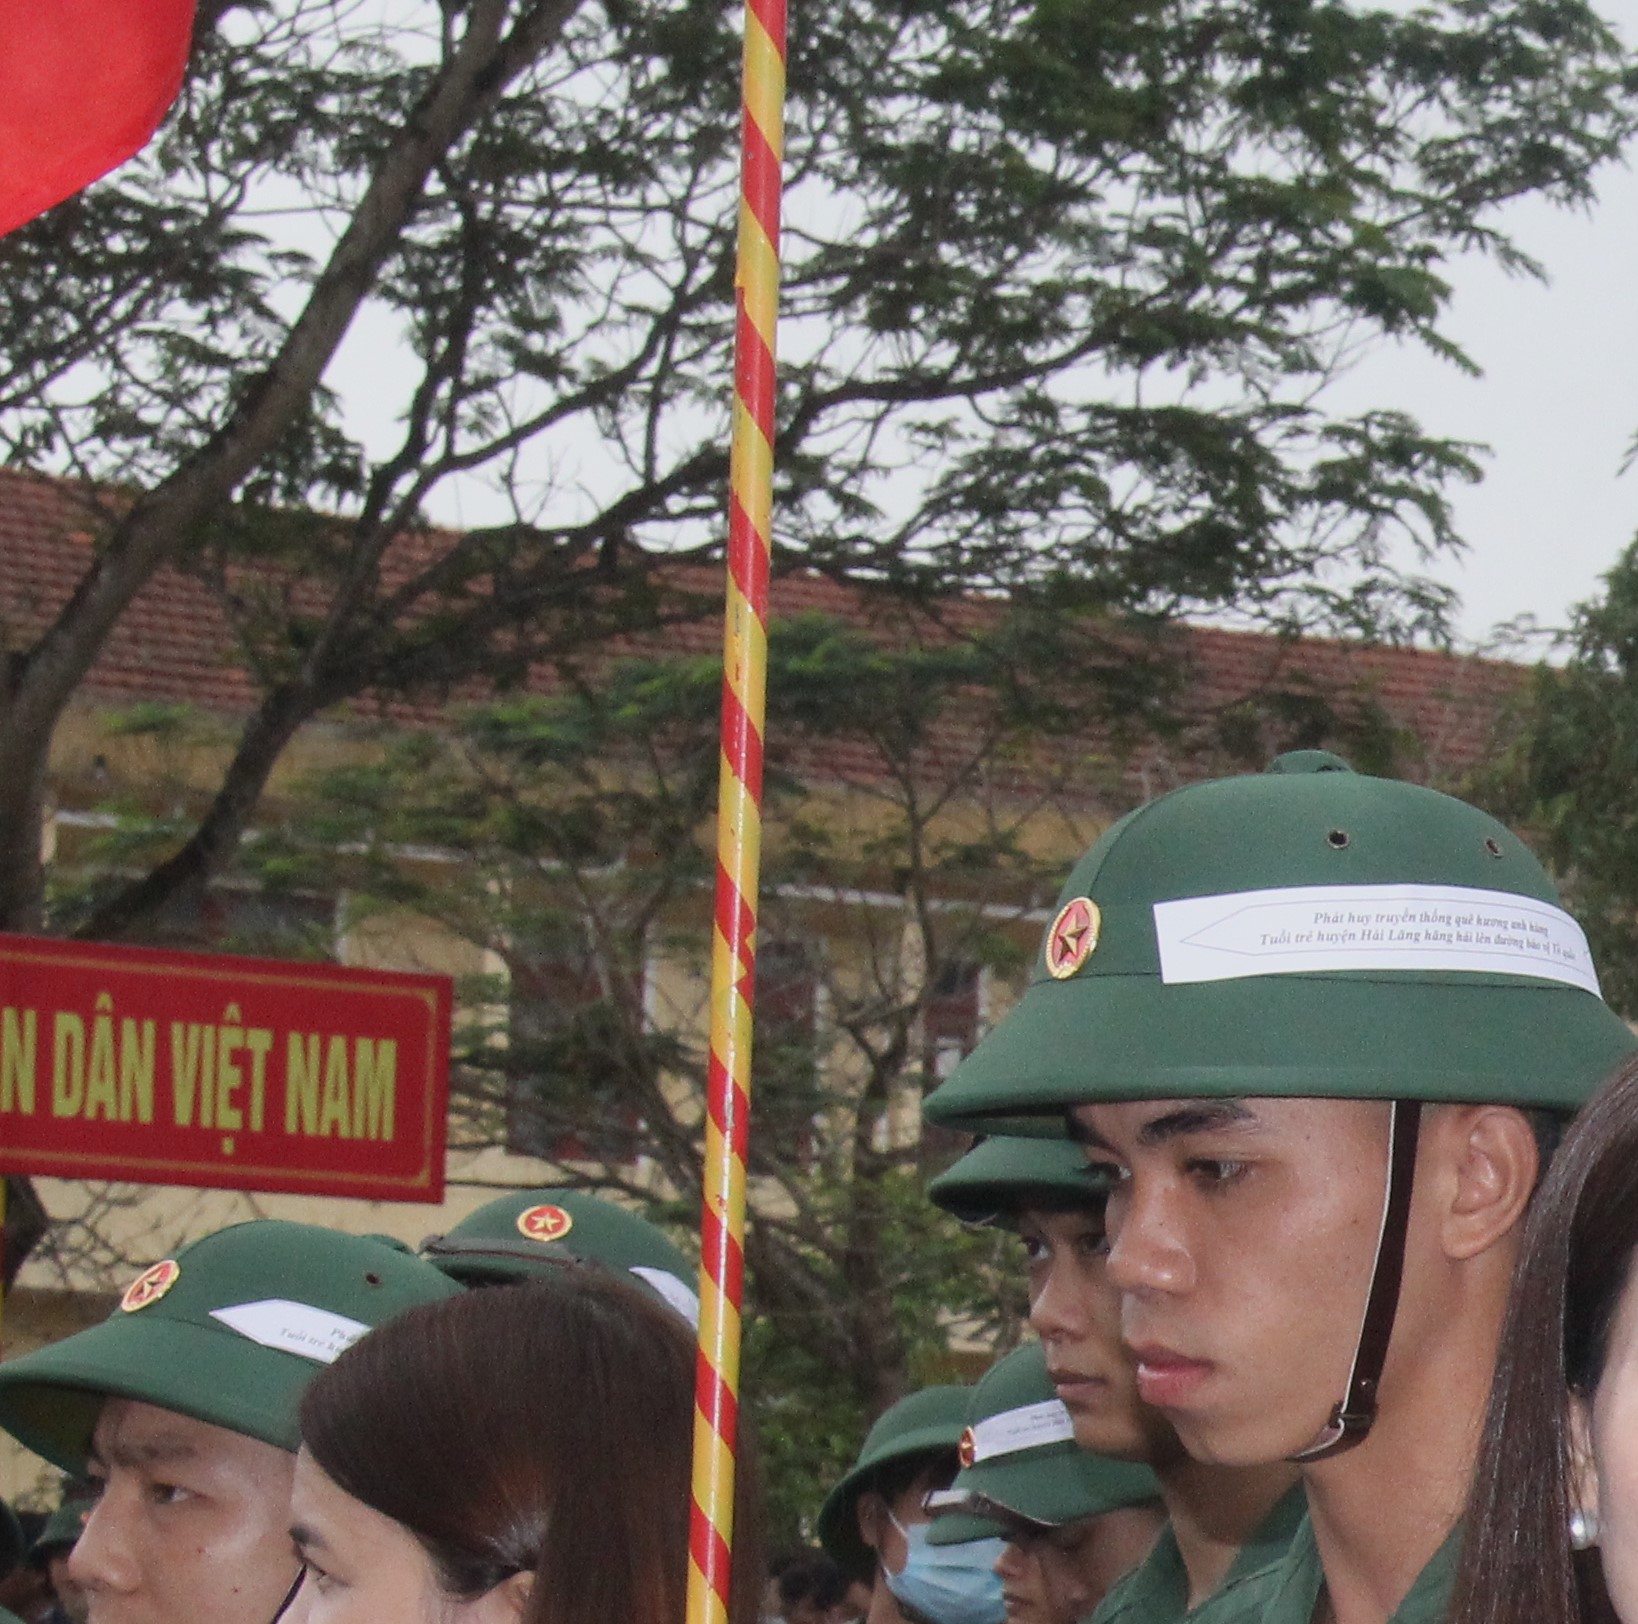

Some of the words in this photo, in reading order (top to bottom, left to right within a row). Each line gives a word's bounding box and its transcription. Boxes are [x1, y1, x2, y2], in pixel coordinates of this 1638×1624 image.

[1314, 911, 1344, 925] Phát
[1349, 912, 1371, 926] huy
[1375, 907, 1416, 926] truyền
[1419, 908, 1452, 926] thống
[1455, 913, 1474, 927] quê
[1260, 928, 1291, 945] Tuổi
[1317, 928, 1356, 944] huyện
[1389, 928, 1420, 942] Lăng
[52, 992, 156, 1123] DÂN
[171, 1003, 273, 1155] VIỆT
[285, 1031, 397, 1141] NAM
